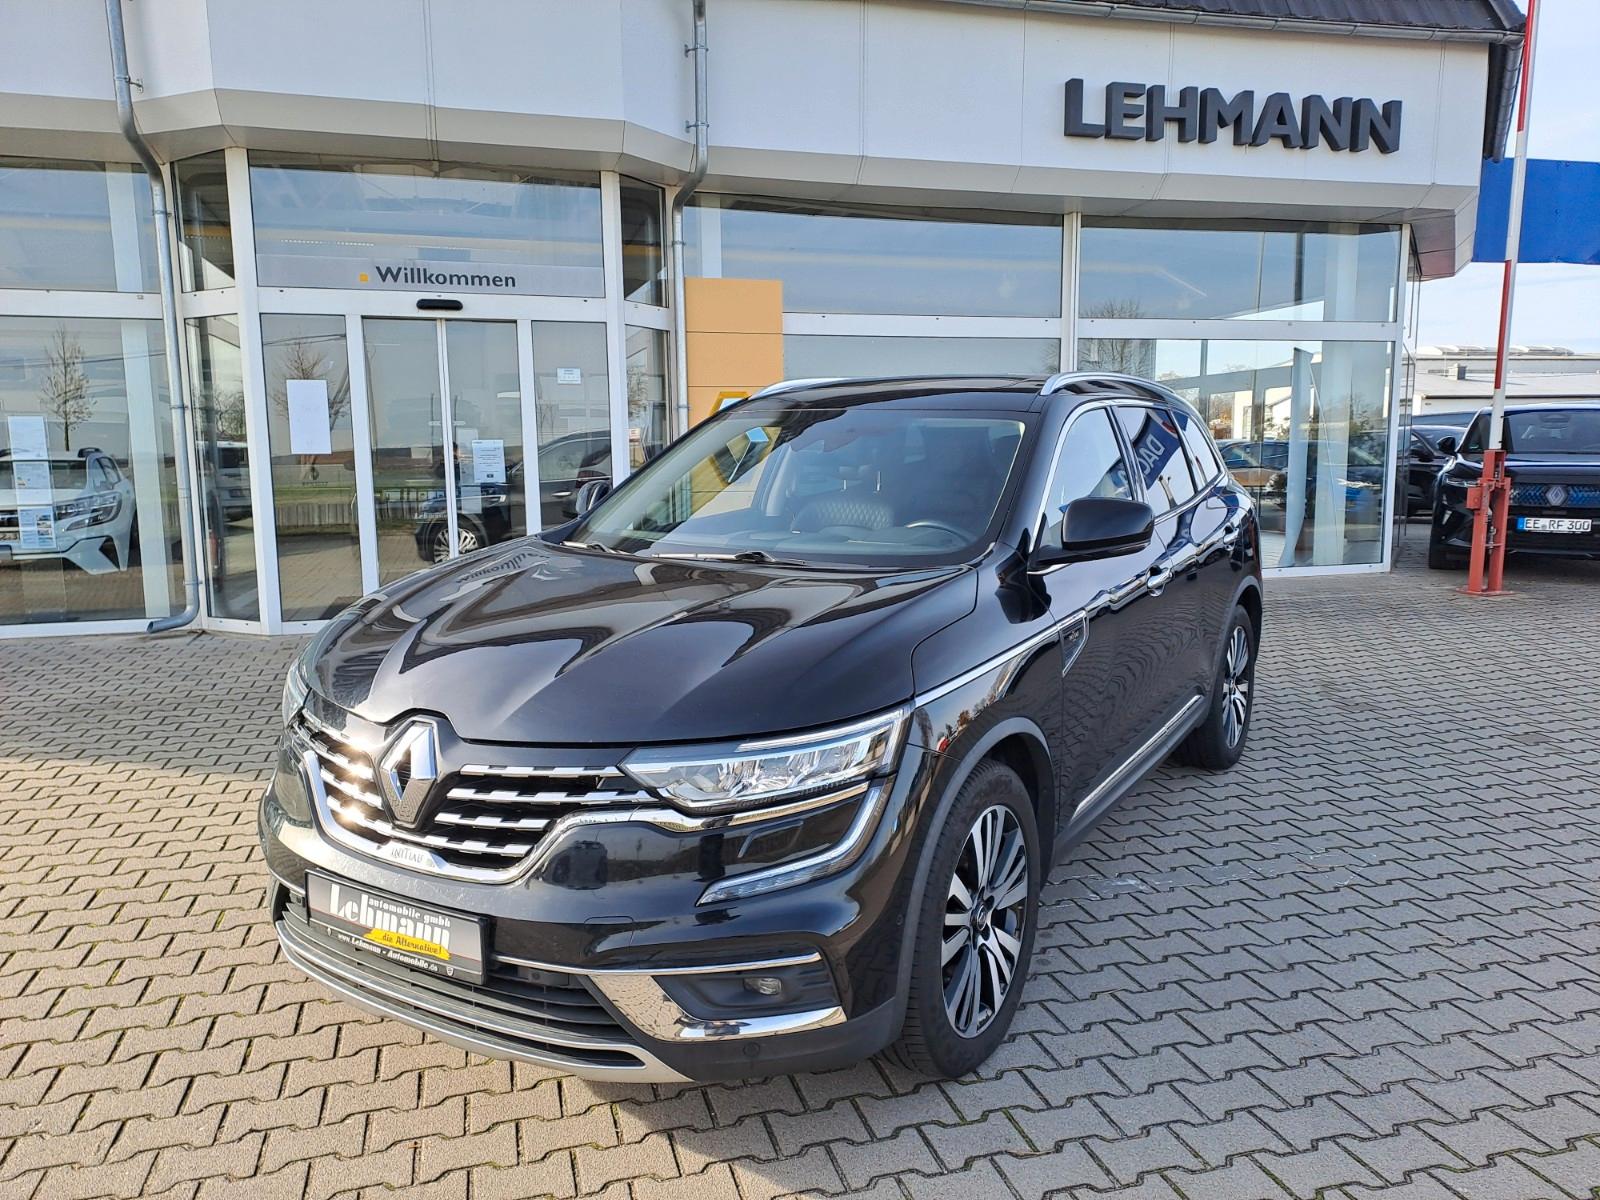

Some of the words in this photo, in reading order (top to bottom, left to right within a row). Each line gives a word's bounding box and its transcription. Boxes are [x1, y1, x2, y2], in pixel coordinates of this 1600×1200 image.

[1064, 78, 1402, 154] LEHMANN
[376, 266, 516, 287] Willkommen
[1525, 519, 1540, 529] EE
[1548, 519, 1564, 530] RF
[1567, 520, 1590, 531] 300
[330, 883, 450, 950] Lehmann
[369, 898, 420, 919] automobile
[423, 914, 450, 928] gmbh
